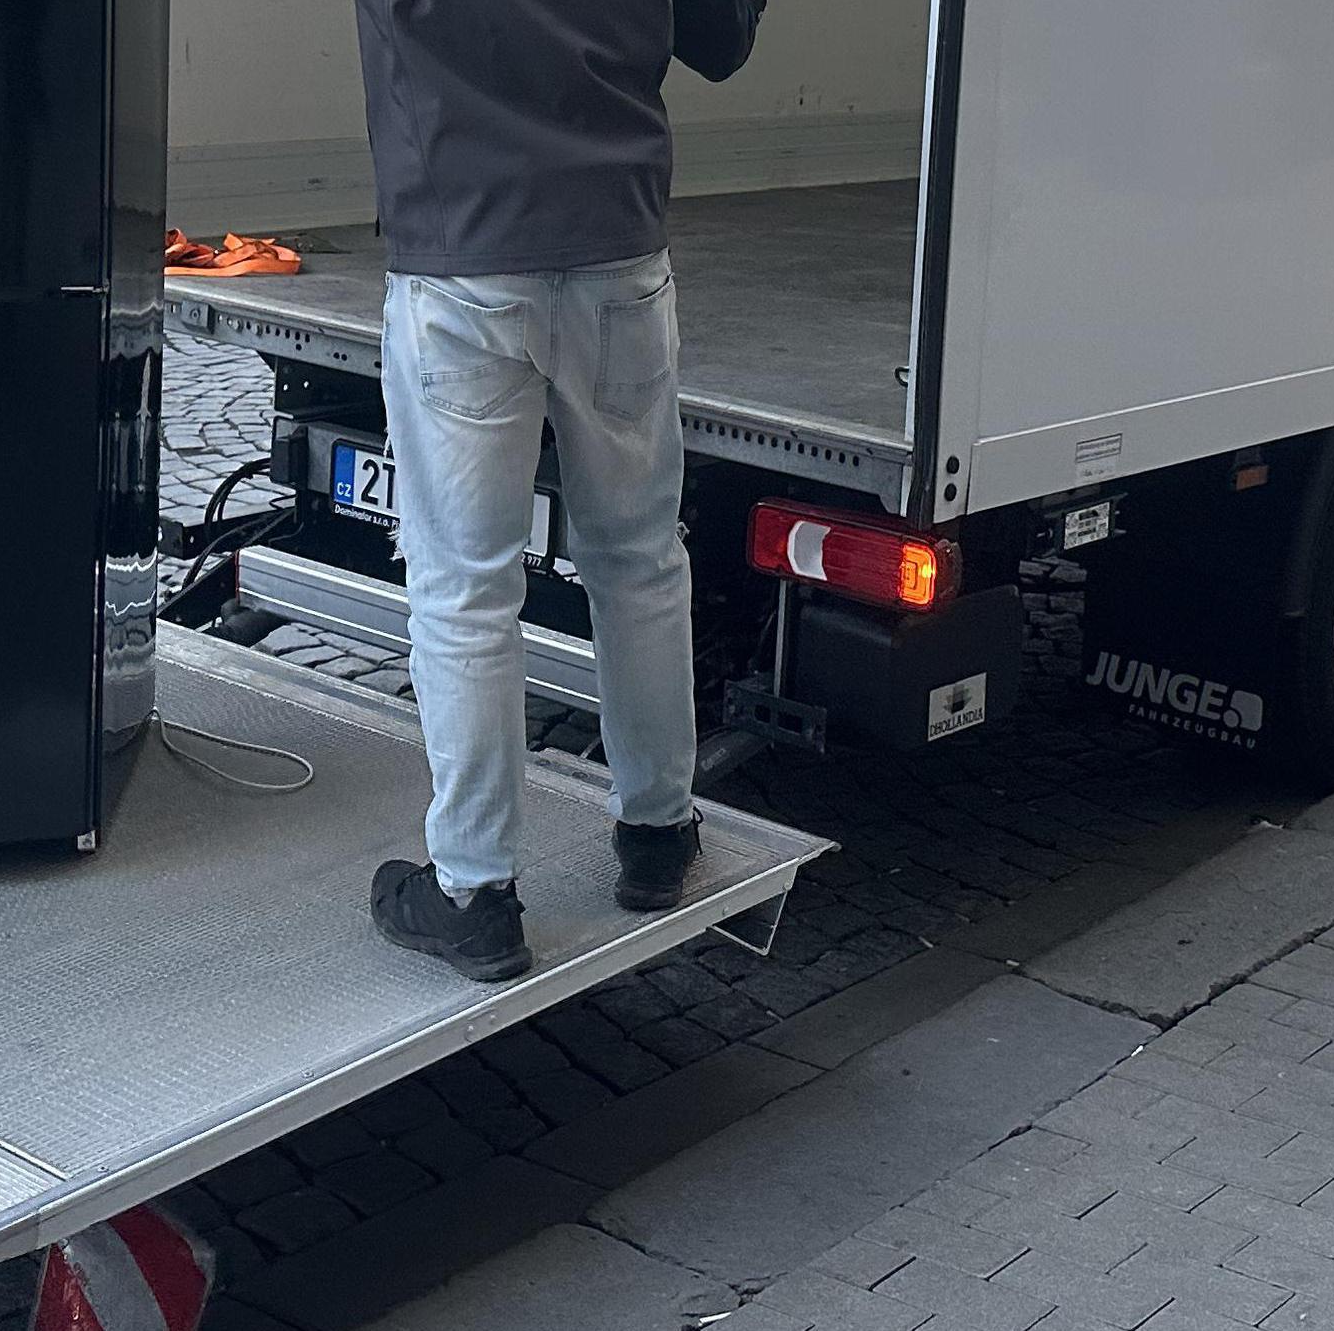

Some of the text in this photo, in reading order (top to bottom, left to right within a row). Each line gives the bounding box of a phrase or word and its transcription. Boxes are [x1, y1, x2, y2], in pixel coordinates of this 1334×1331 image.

[336, 481, 353, 498] CZ
[1086, 651, 1228, 720] JUNGE
[929, 707, 984, 738] DHOLLANDIA
[1128, 704, 1256, 749] FAHRZEUGBAU
